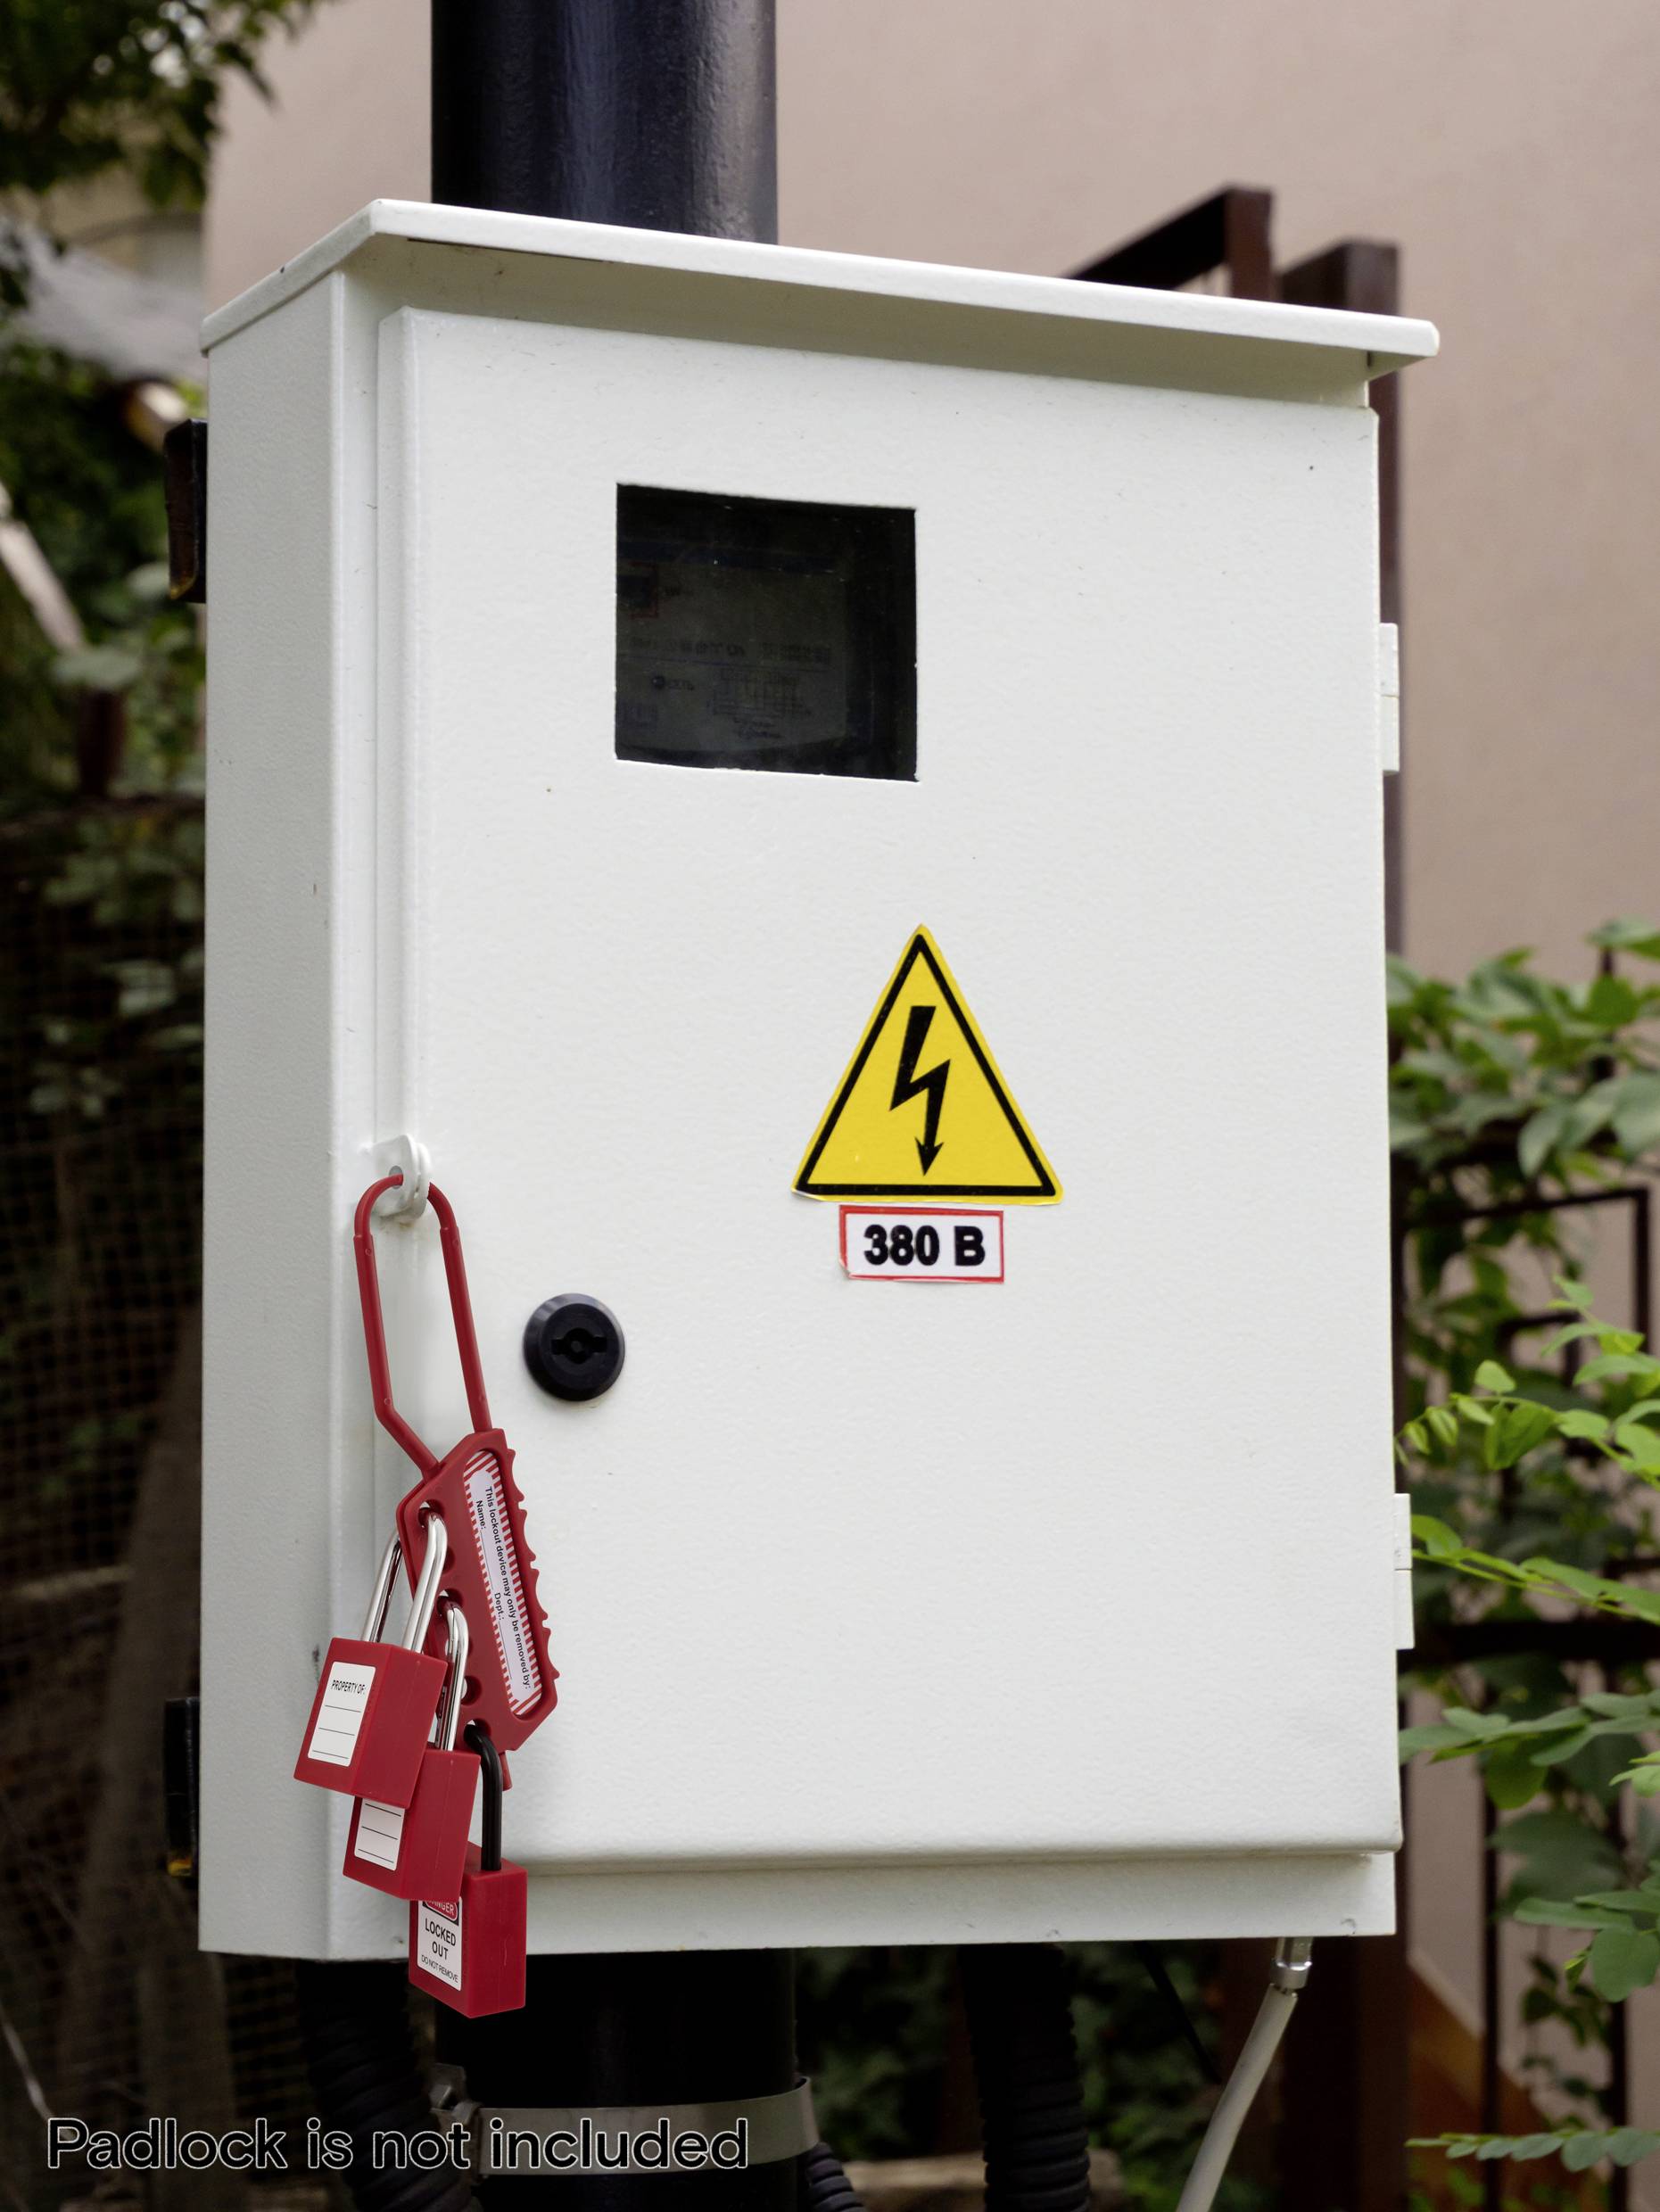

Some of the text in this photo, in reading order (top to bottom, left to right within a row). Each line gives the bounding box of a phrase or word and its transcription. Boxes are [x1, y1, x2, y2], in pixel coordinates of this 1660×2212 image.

[863, 1224, 940, 1267] 380
[475, 1500, 487, 1530] Name:
[484, 1486, 532, 1689] This lockout device may only be removed by:
[331, 1679, 358, 1694] PROPERTY
[425, 1918, 457, 1946] LOCKED
[432, 1941, 449, 1960] OUT
[421, 1954, 458, 1983] DO NOT REMOVE
